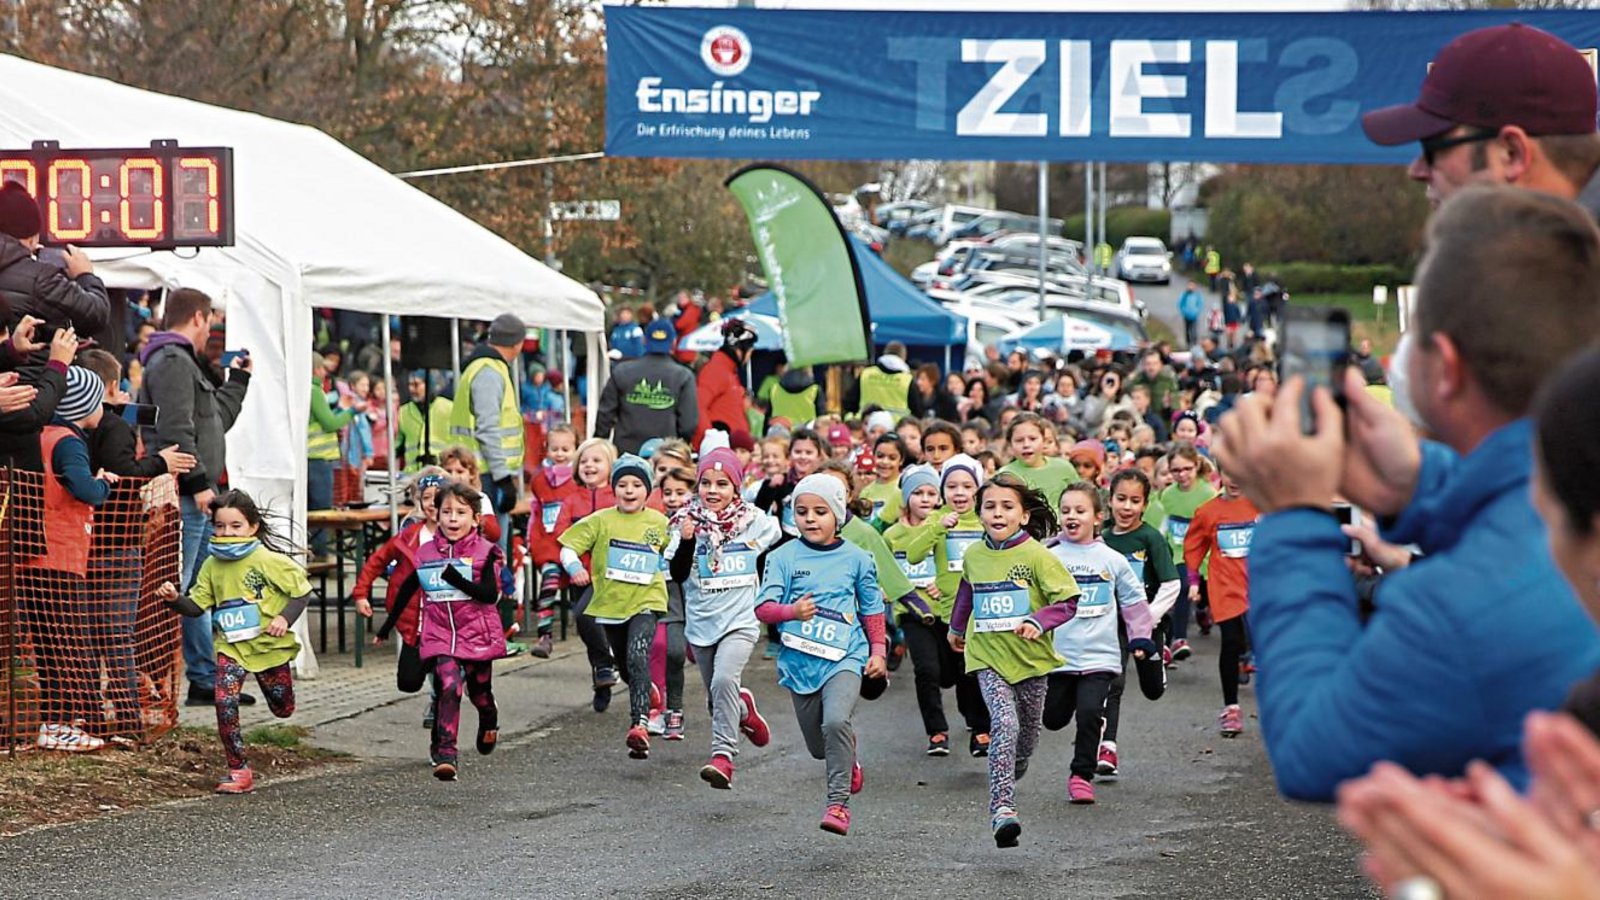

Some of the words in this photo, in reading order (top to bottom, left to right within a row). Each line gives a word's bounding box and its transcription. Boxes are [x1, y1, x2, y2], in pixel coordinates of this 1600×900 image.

[956, 39, 1283, 138] ZIEL
[635, 76, 821, 123] Ensinger
[637, 124, 656, 136] Die
[659, 123, 725, 141] Erfrischung
[728, 125, 767, 138] deines
[769, 126, 811, 140] Lebens
[620, 553, 646, 570] 471
[1080, 585, 1099, 603] 57
[981, 595, 1014, 615] 469
